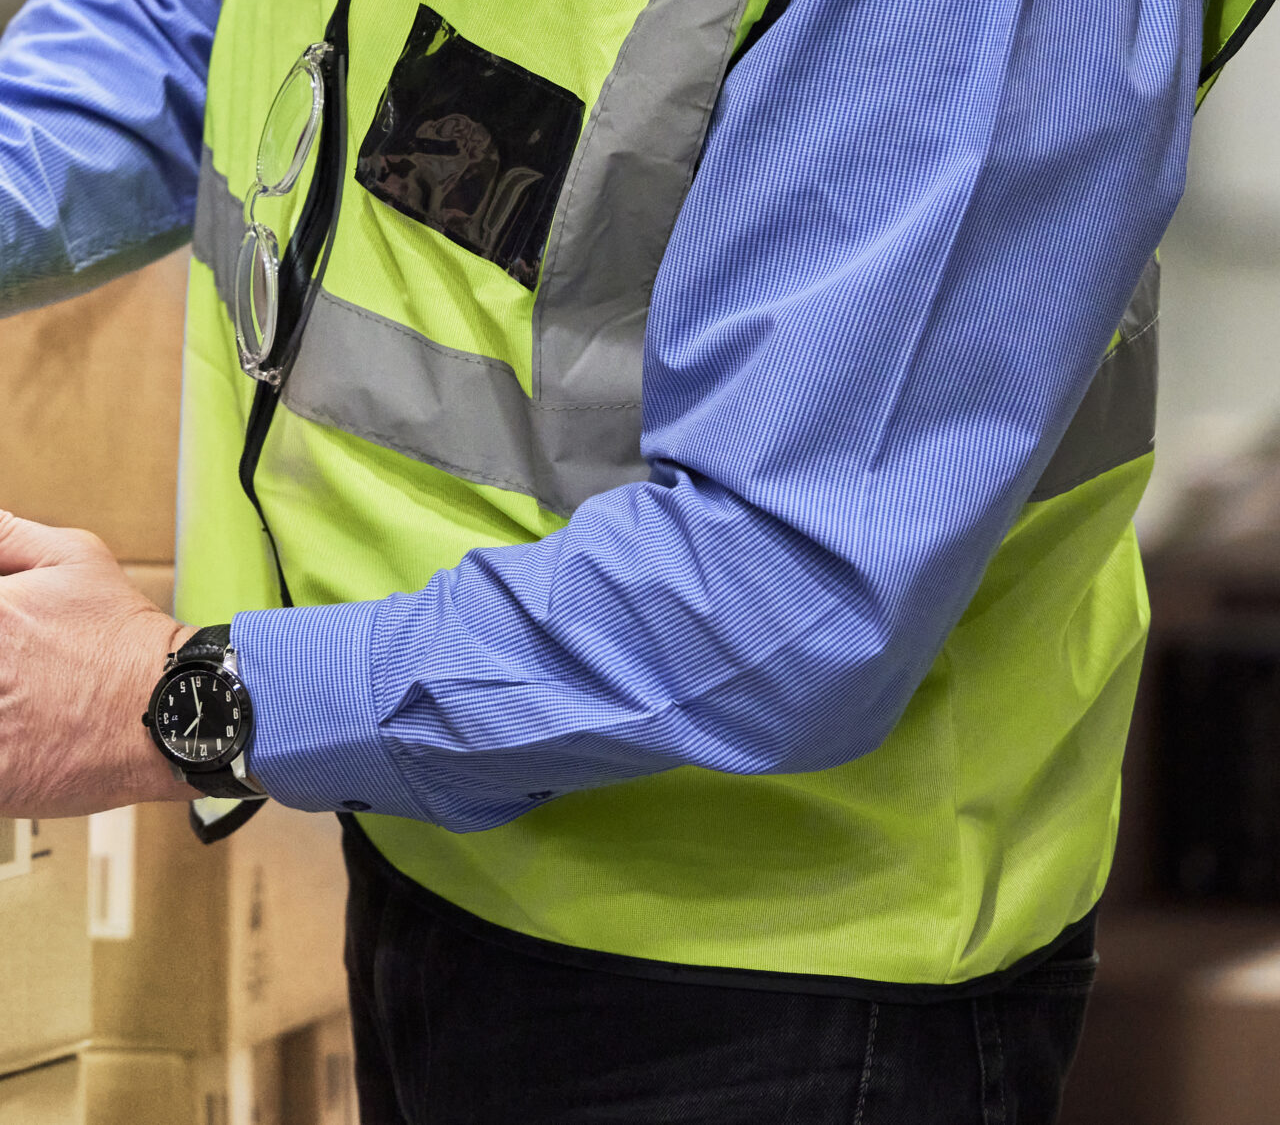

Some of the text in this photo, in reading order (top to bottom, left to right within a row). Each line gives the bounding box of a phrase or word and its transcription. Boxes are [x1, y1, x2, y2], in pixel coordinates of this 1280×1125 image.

[180, 681, 186, 693] 5
[213, 679, 218, 691] 7
[168, 694, 174, 706] 4
[226, 690, 231, 702] 8
[163, 712, 169, 724] 3
[233, 708, 239, 719] 9
[170, 730, 177, 742] 2
[226, 725, 234, 737] 10
[200, 744, 208, 756] 12
